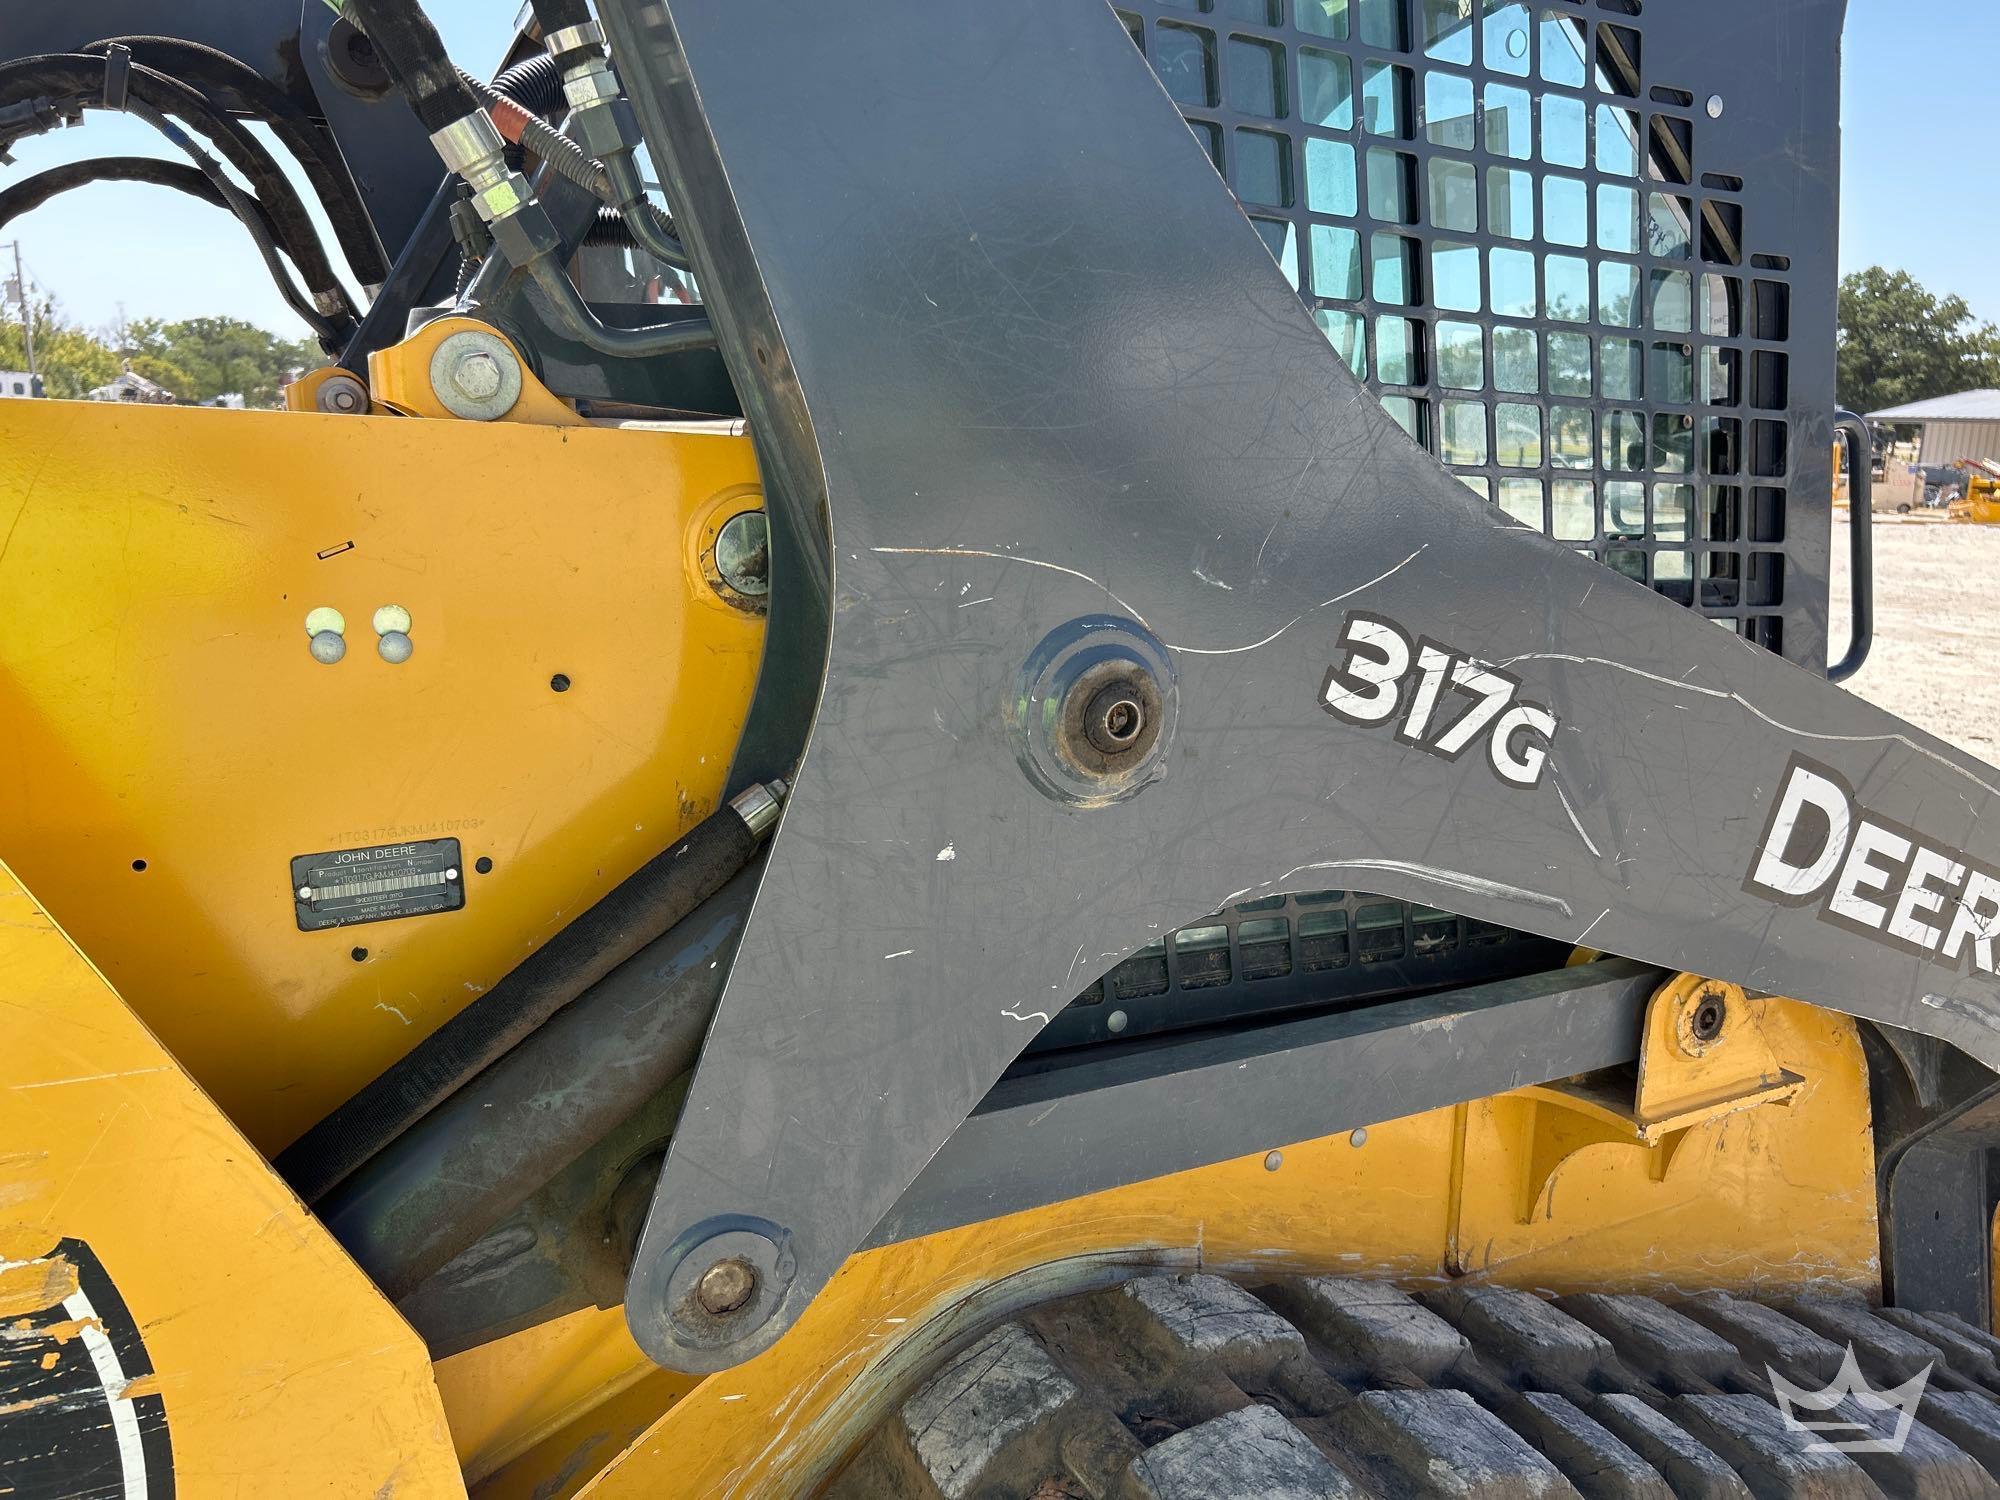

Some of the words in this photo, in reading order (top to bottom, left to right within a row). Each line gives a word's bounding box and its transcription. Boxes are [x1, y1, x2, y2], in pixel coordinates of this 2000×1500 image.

[1325, 619, 1557, 783] 317G
[334, 852, 370, 864] JOHN
[375, 845, 417, 858] DEERE
[319, 869, 346, 878] Product
[353, 863, 401, 874] Identification
[407, 858, 434, 866] Number
[1753, 766, 2000, 975] DEER
[361, 905, 378, 913] MADE
